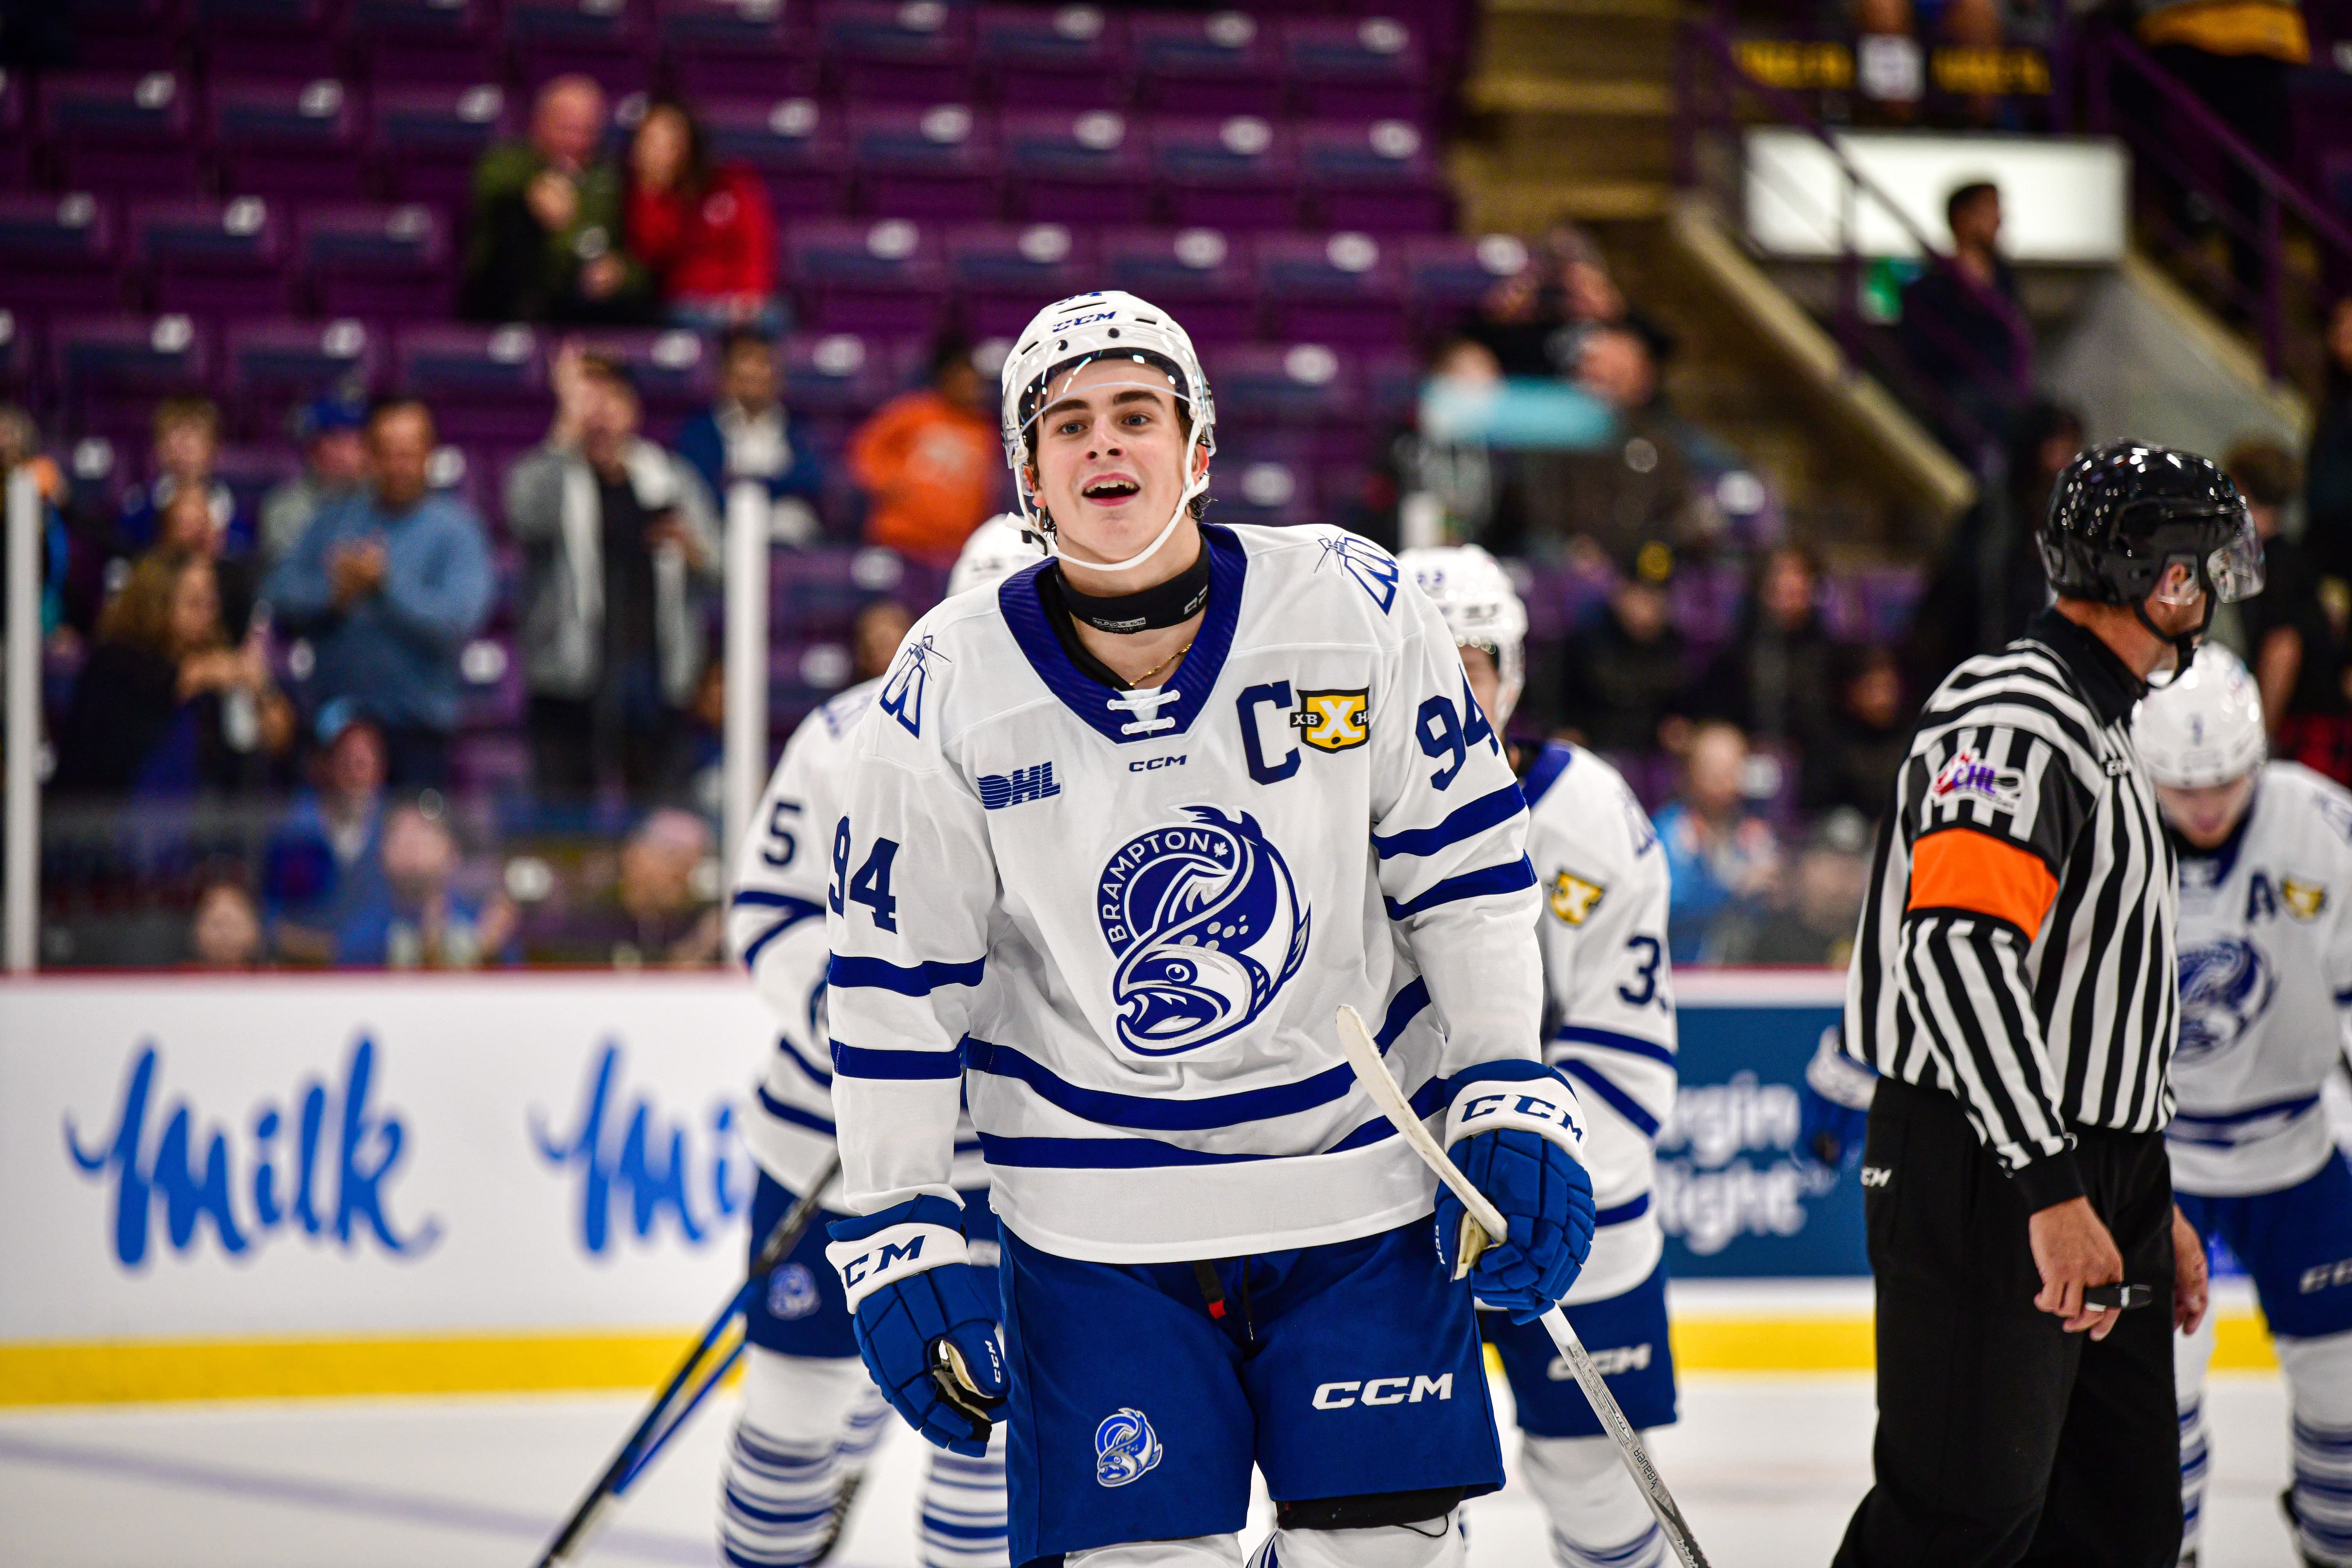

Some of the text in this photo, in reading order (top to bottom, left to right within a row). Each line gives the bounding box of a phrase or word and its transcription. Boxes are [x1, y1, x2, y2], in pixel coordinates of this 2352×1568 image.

[1052, 311, 1117, 332] CCM
[1236, 681, 1301, 785] C
[1357, 711, 1369, 724] H
[1417, 663, 1499, 791] 94
[977, 761, 1060, 810] OHL
[1129, 755, 1187, 772] CCM
[1953, 764, 1996, 795] CHL
[763, 802, 802, 866] 5
[828, 814, 899, 935] 94
[1102, 832, 1209, 942] BRAMPTON
[2247, 872, 2276, 921] A
[1618, 934, 1669, 1014] 3
[1462, 1095, 1583, 1144] CCM
[65, 1030, 442, 1270] Milk
[531, 1035, 752, 1256] Mi
[1860, 1167, 1891, 1187] CM
[842, 1235, 926, 1289] CM
[1435, 1225, 1446, 1265] CCM
[985, 1340, 1001, 1383] CCM
[1312, 1373, 1453, 1410] CCM
